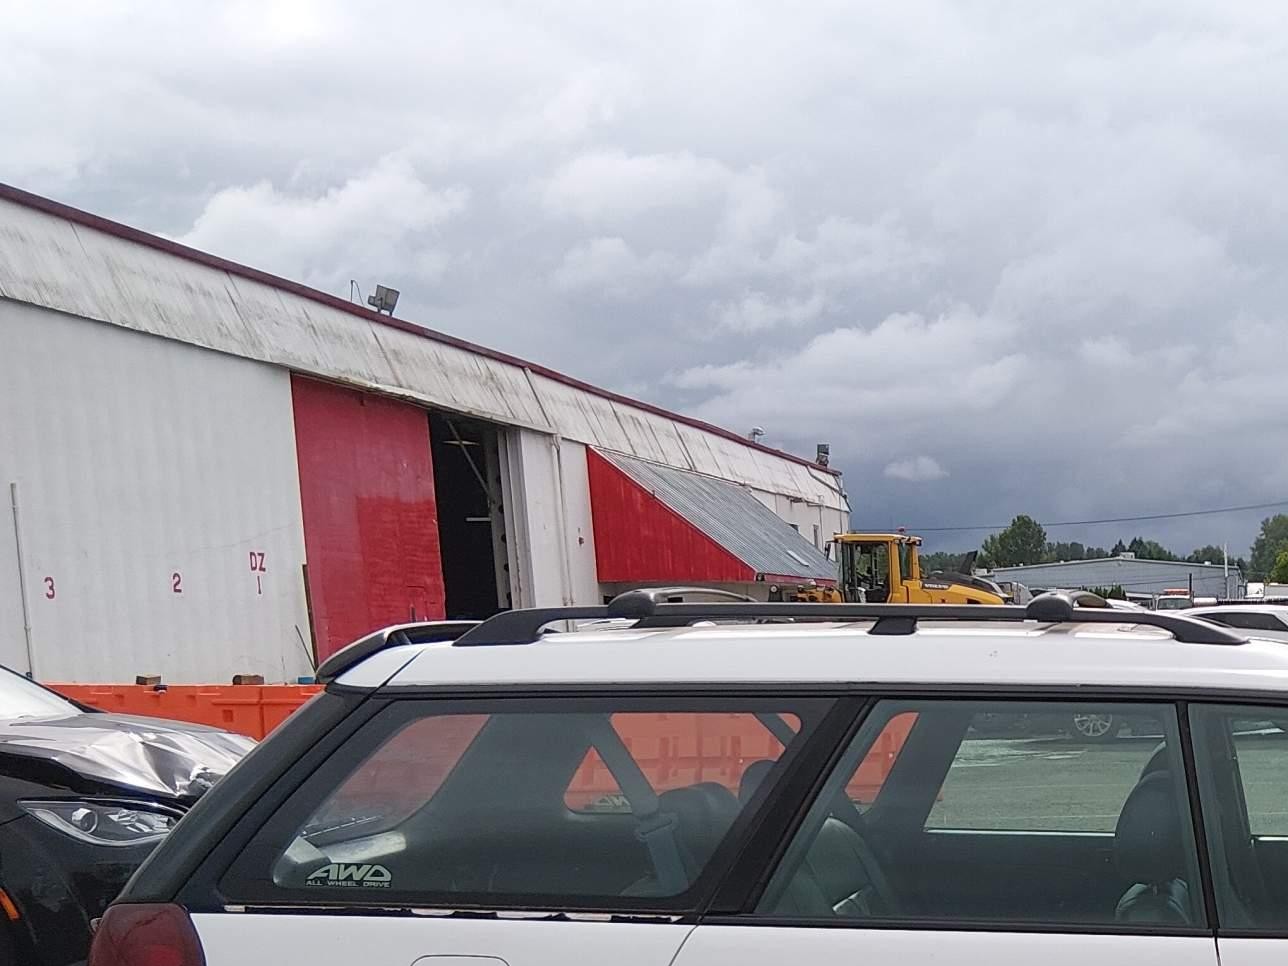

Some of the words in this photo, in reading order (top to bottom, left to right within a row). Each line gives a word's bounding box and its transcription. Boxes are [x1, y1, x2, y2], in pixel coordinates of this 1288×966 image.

[249, 551, 266, 572] DZ
[44, 576, 56, 600] 3
[172, 573, 183, 593] 2
[306, 863, 393, 881] AWD
[362, 880, 391, 888] DRIVE
